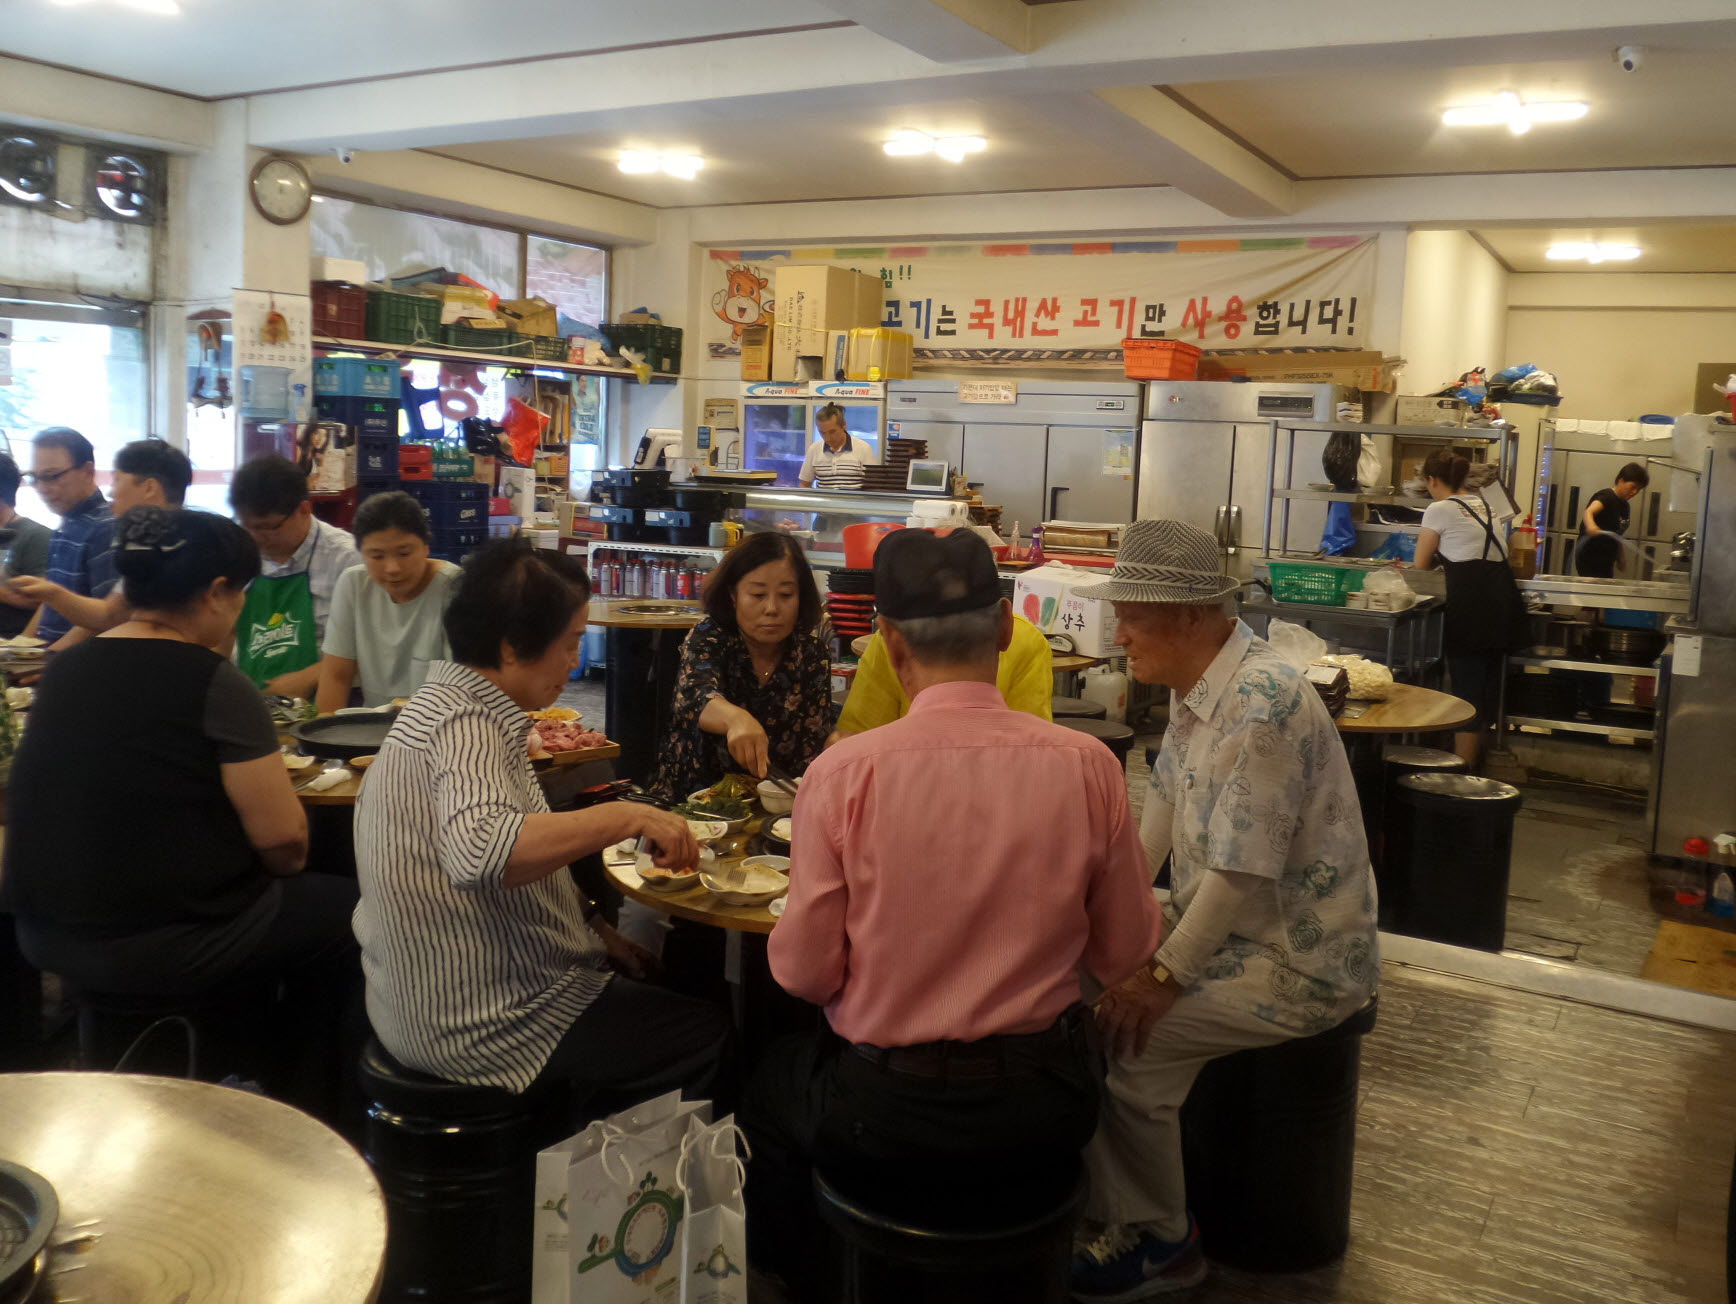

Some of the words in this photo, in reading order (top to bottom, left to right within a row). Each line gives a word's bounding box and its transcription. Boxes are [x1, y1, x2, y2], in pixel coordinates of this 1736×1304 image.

[880, 298, 956, 340] 고기는
[967, 296, 1061, 340] 국내산
[1073, 296, 1167, 339] 고기만
[1181, 295, 1248, 340] 사용
[1253, 296, 1358, 337] 합니다!
[765, 387, 783, 395] Aqua
[855, 388, 871, 396] FINE
[1061, 612, 1086, 632] 상추
